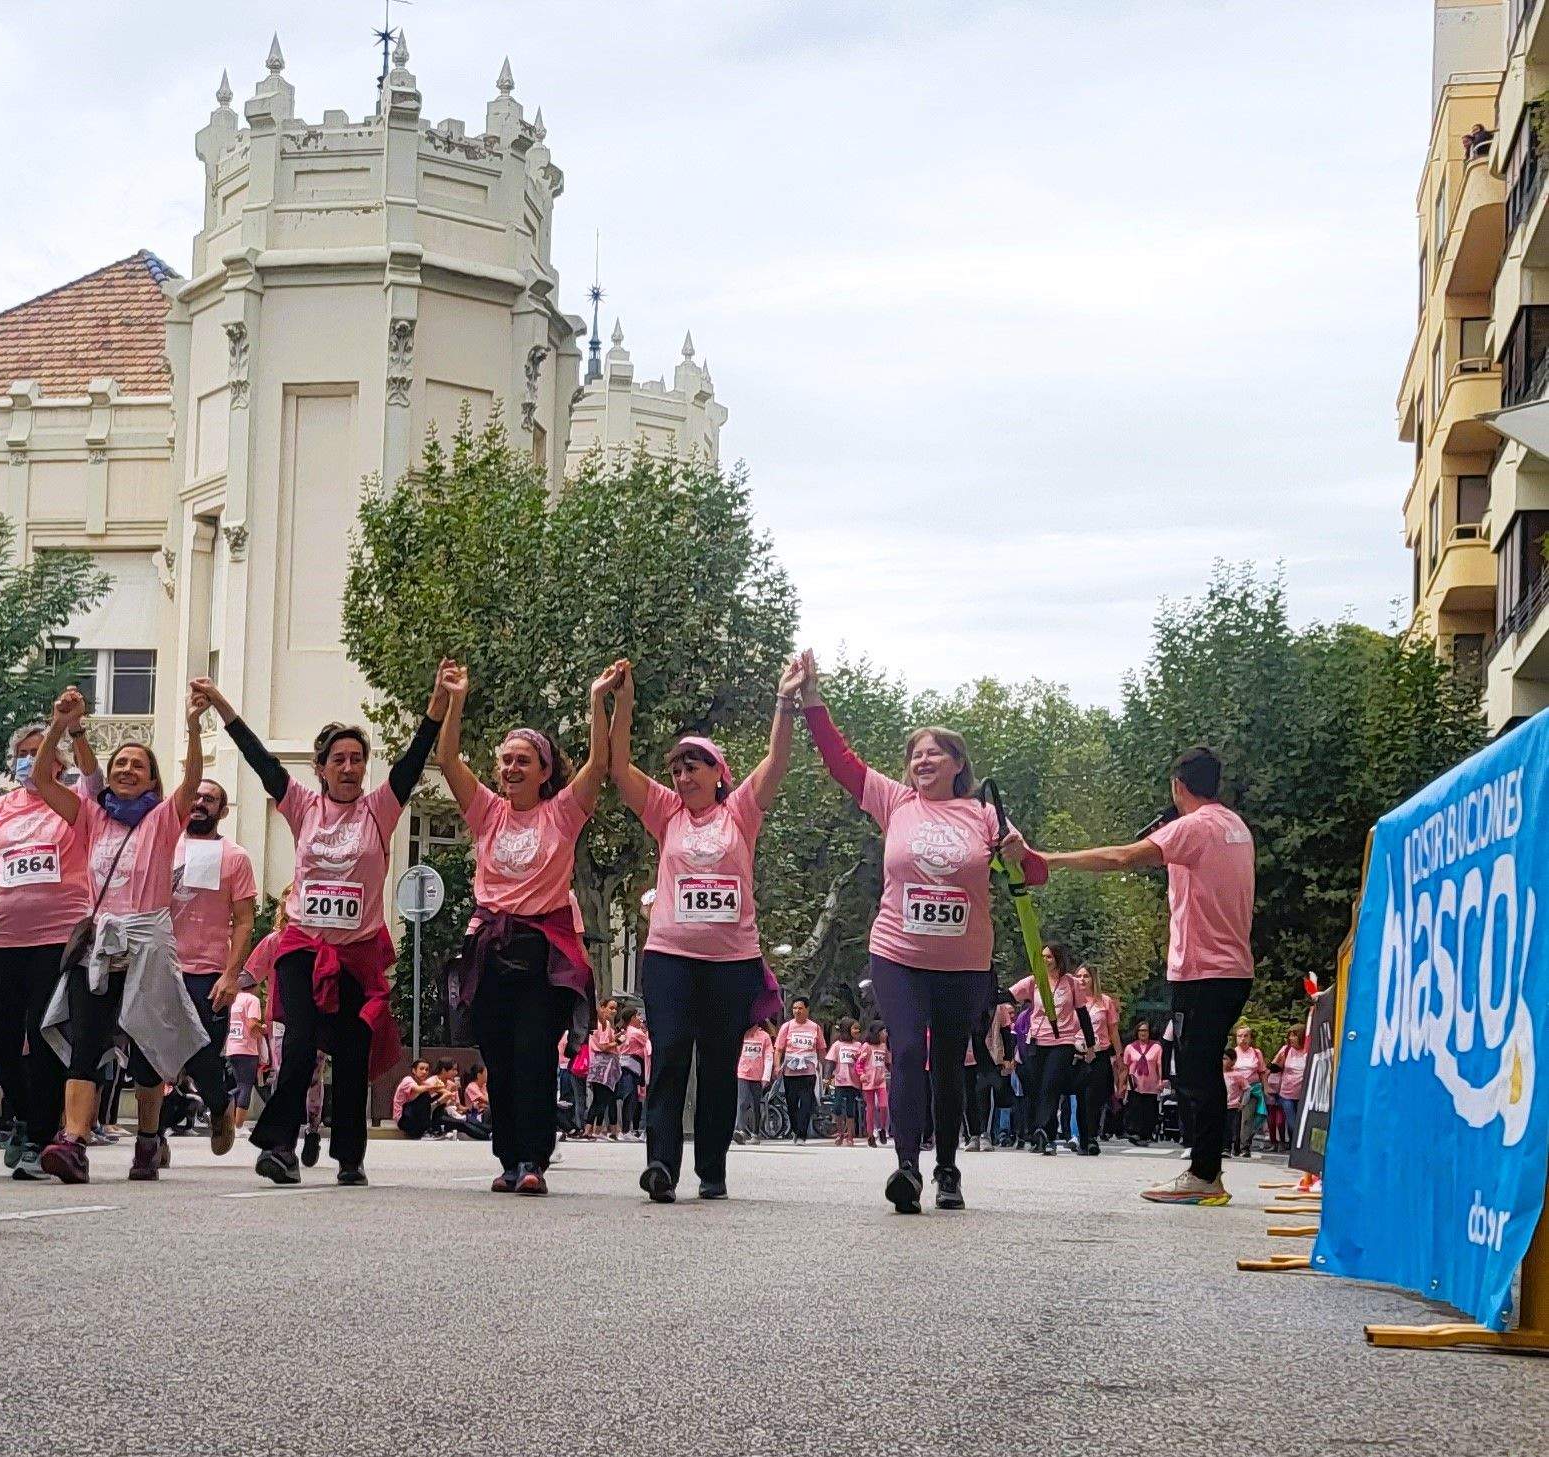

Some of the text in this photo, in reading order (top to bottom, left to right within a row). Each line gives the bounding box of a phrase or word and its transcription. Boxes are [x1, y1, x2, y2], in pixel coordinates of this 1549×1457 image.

[6, 855, 56, 877] 1864
[306, 896, 359, 918] 2010
[682, 891, 737, 910] 1854
[910, 902, 965, 923] 1850
[1370, 836, 1519, 1066] blasco
